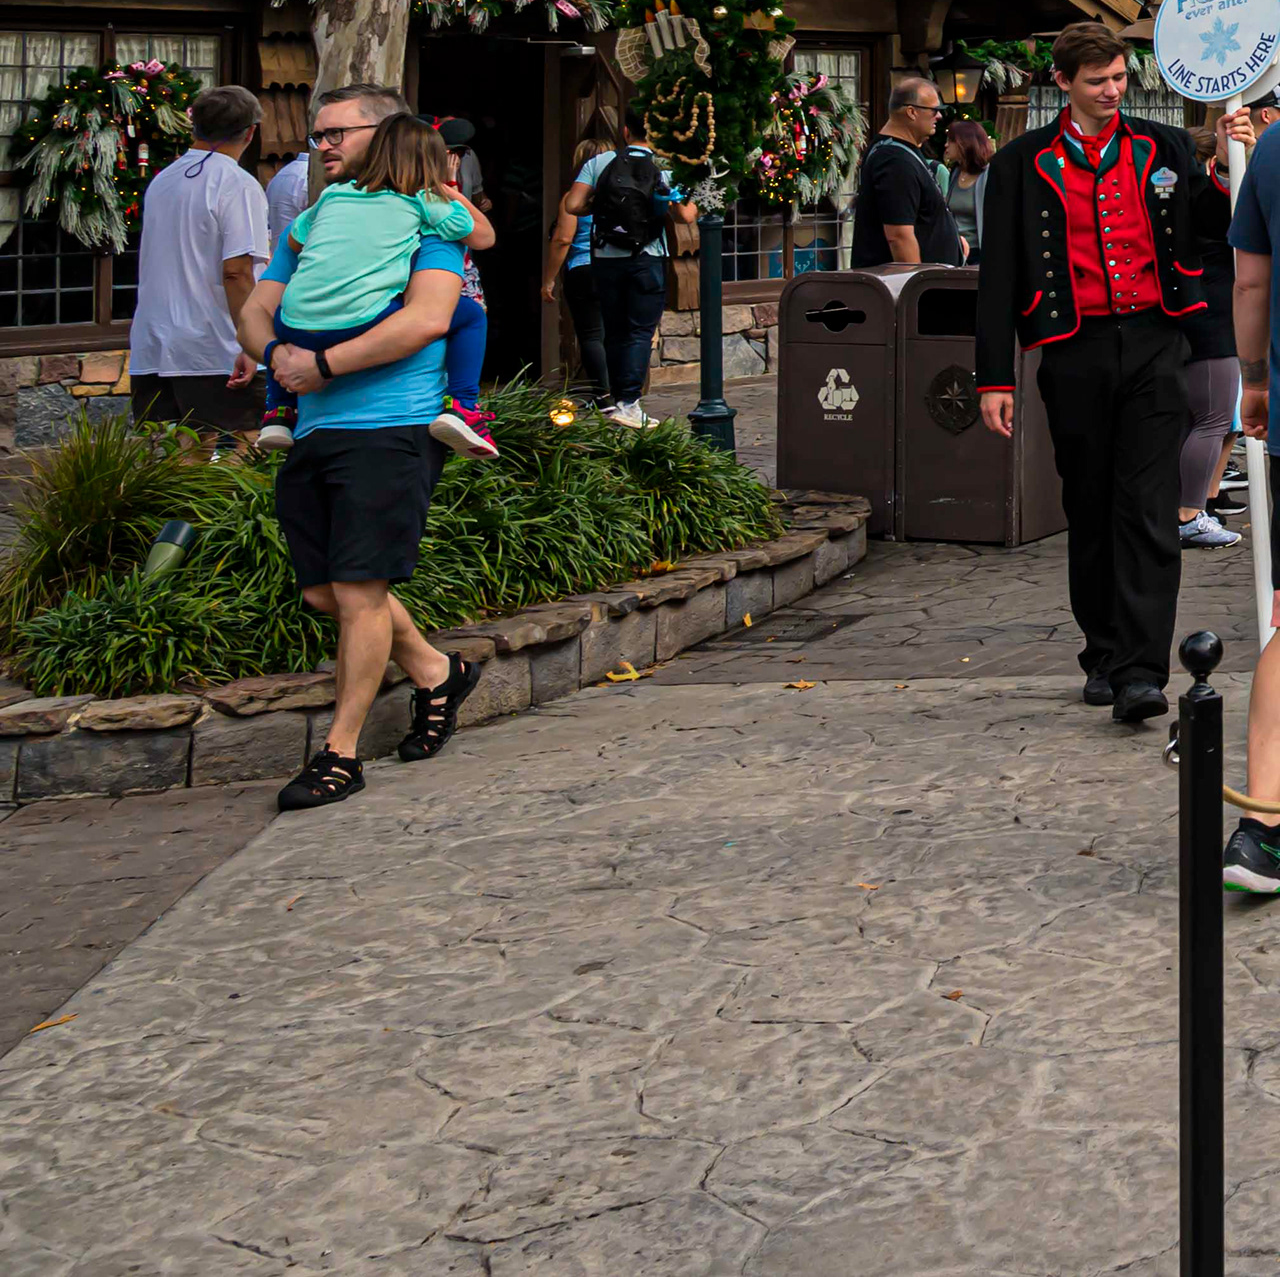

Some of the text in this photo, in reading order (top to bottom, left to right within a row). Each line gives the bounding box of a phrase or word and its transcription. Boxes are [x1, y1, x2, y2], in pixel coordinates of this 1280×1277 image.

[1185, 5, 1213, 21] ever
[1167, 32, 1276, 94] LINE STARTS HERE
[823, 413, 853, 421] RECYCLE
